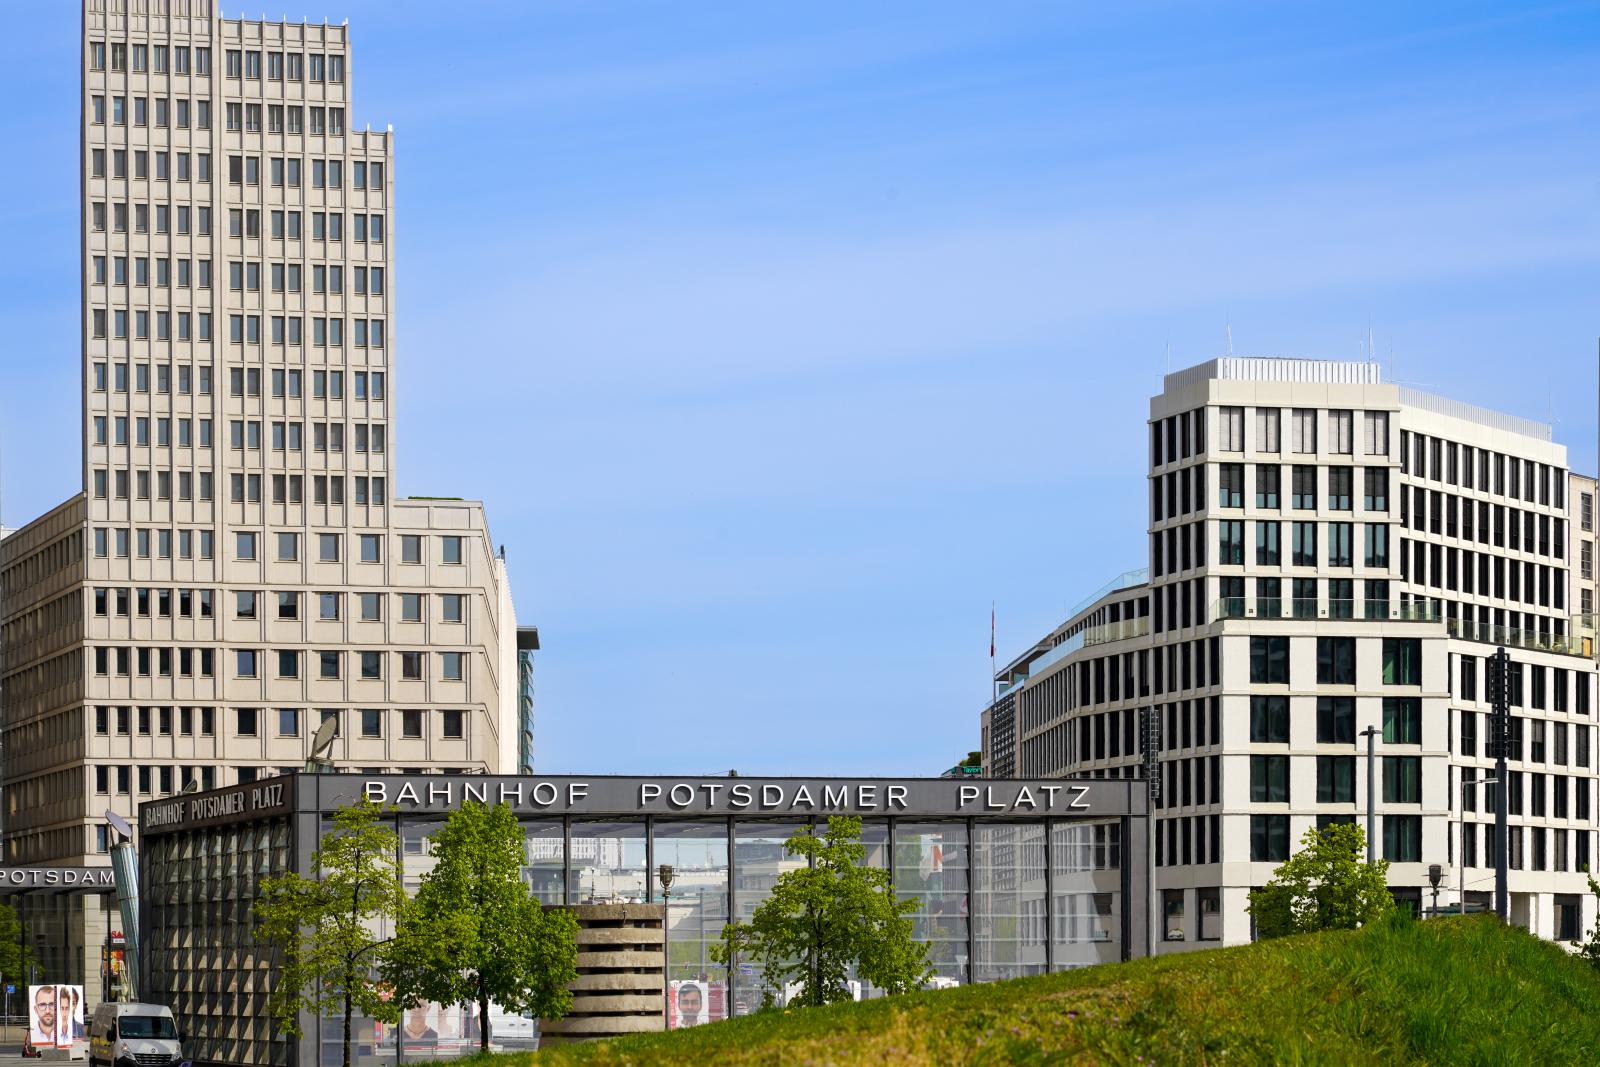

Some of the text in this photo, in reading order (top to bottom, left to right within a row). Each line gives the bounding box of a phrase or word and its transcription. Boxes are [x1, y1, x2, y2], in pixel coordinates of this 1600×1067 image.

[146, 783, 283, 828] BAHNHOF POTSDAMER PLATZ
[365, 781, 1091, 807] BAHNHOF POTSDAMER PLATZ
